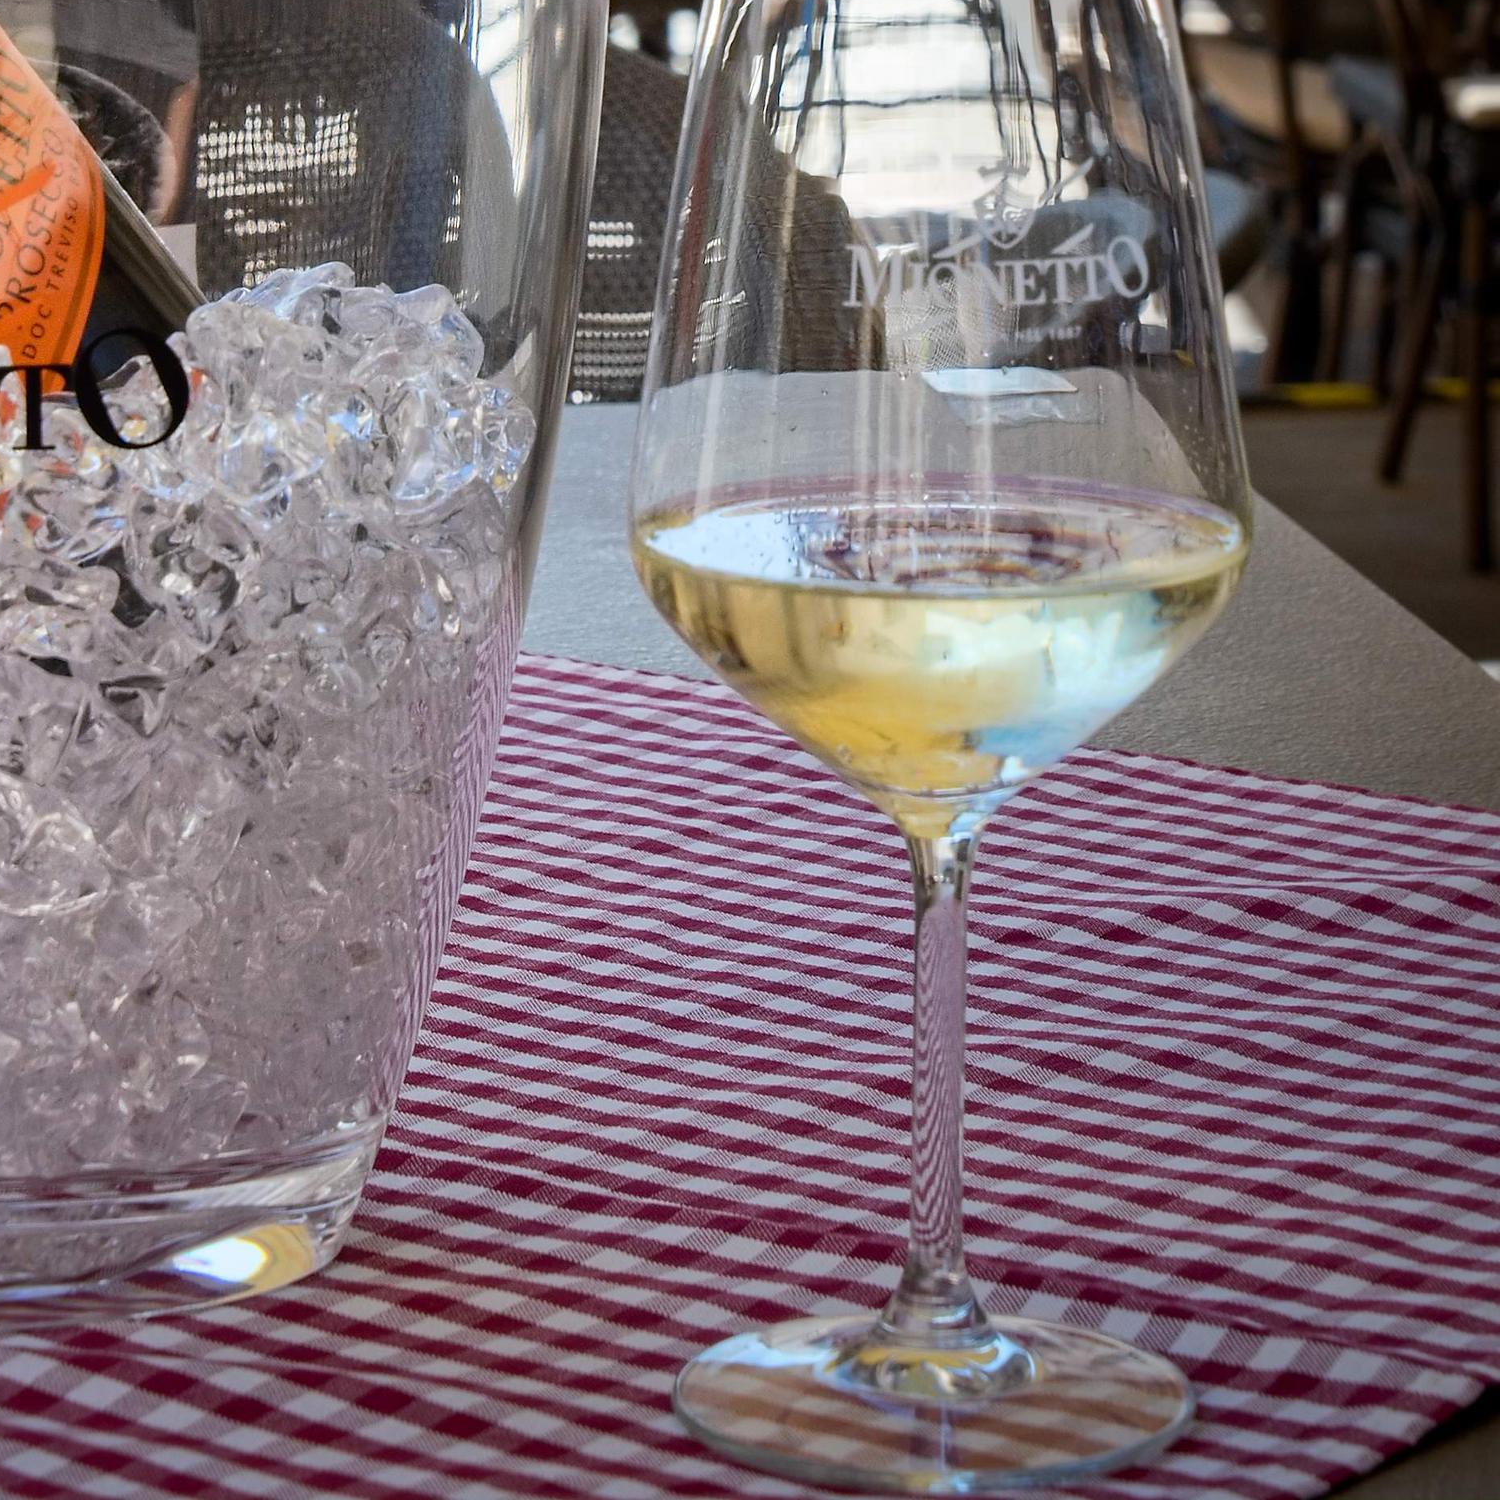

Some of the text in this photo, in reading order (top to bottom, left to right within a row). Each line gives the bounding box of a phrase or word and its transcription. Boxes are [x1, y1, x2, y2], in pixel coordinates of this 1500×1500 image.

[20, 303, 53, 360] DOC
[45, 196, 79, 292] TREVISO
[842, 234, 1149, 308] MIONETTO
